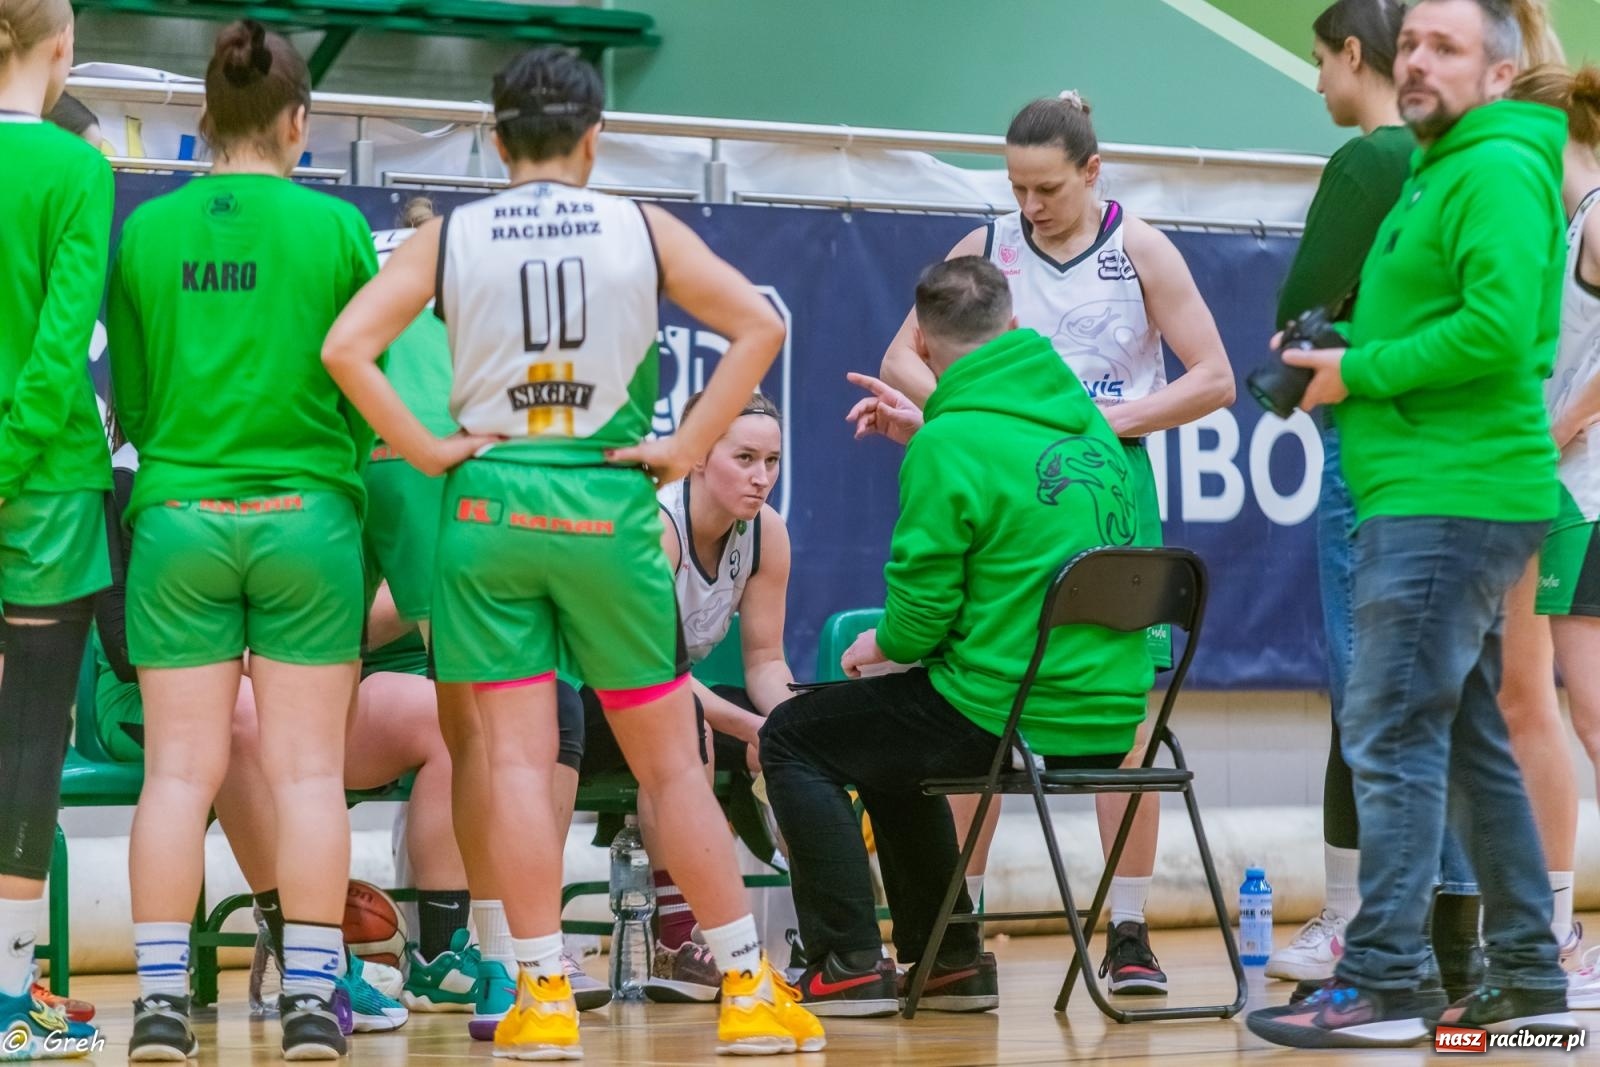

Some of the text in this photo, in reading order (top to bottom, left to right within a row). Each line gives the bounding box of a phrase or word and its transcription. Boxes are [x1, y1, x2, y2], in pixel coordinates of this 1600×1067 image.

[555, 200, 596, 215] AZS
[491, 218, 604, 241] RACIBÓRZ
[182, 260, 257, 292] KARO
[511, 383, 590, 408] SEGET
[1145, 406, 1325, 526] IBO
[457, 497, 615, 536] K KAMAN
